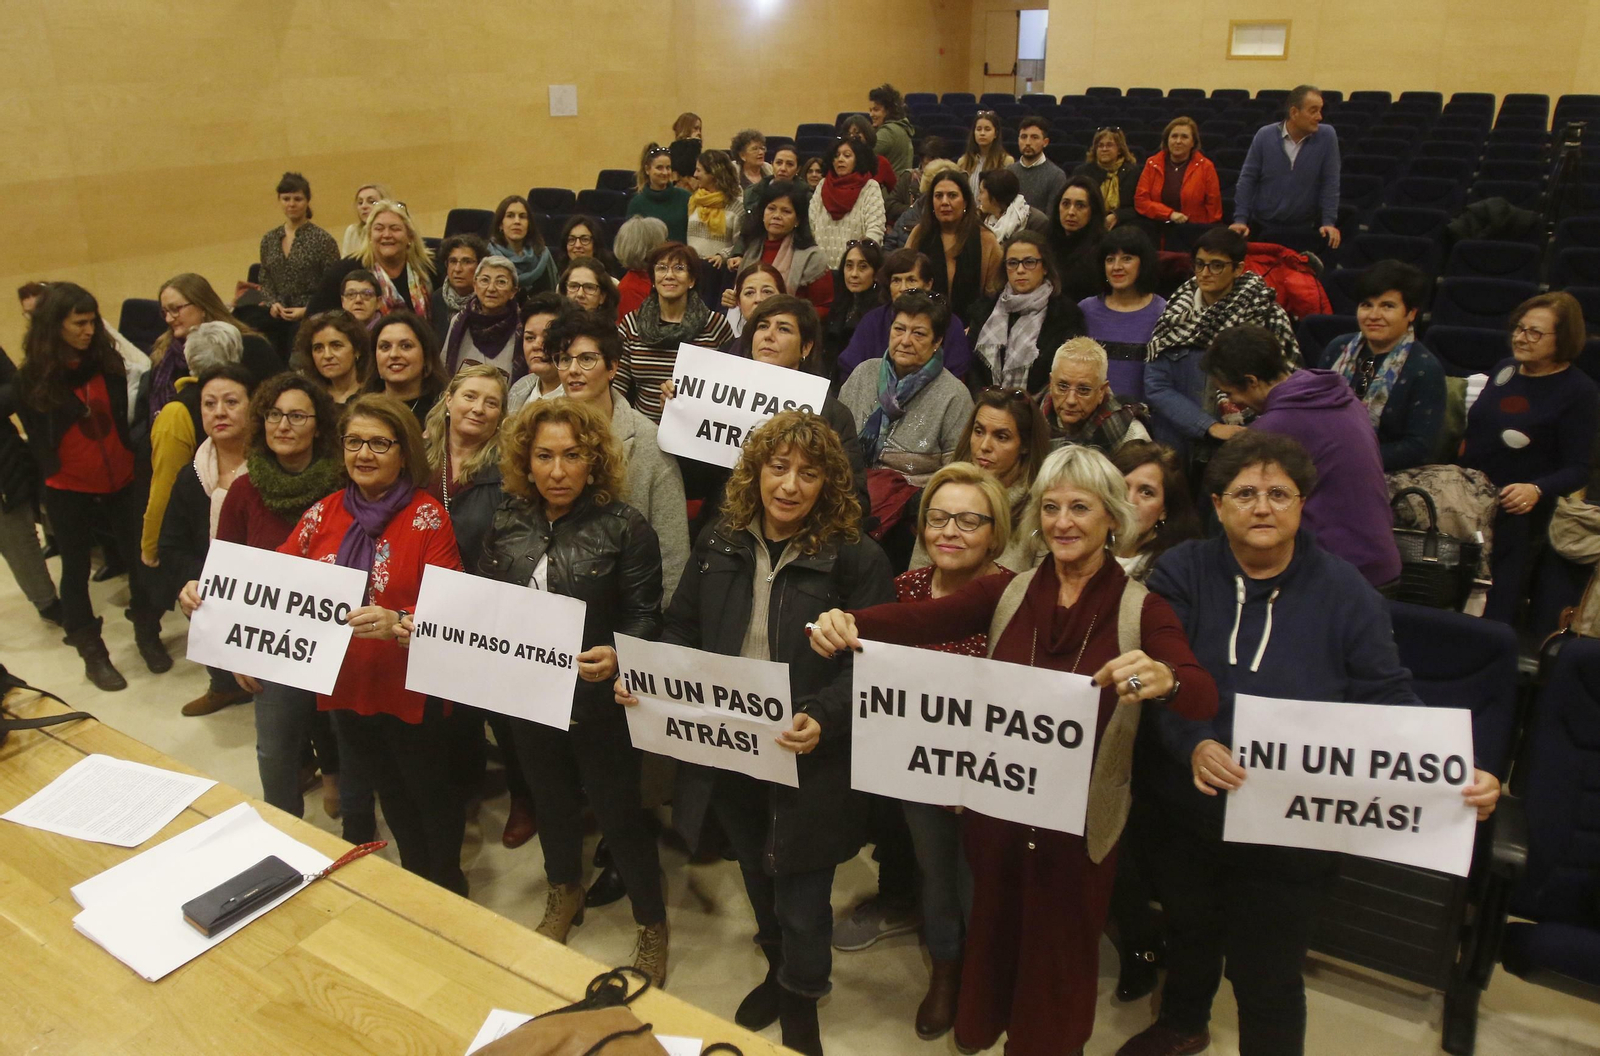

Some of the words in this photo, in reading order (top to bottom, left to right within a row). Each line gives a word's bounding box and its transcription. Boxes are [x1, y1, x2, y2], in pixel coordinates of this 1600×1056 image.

[673, 375, 705, 399] ¡NI
[711, 382, 747, 409] UN
[200, 574, 237, 601] ¡NI
[243, 581, 281, 610] UN
[285, 590, 352, 626] PASO
[225, 623, 318, 664] ATRÁS!
[416, 620, 437, 638] ¡NI
[442, 625, 465, 645] UN
[469, 631, 511, 655] PASO
[514, 642, 573, 670] ATRÁS!
[624, 668, 657, 696] ¡NI
[664, 677, 705, 704] UN
[712, 684, 784, 722] PASO
[859, 685, 907, 719] ¡NI
[921, 692, 973, 727] UN
[985, 703, 1084, 750] PASO
[665, 716, 760, 756] ATRÁS!
[907, 744, 1038, 796] ATRÁS!
[1239, 740, 1288, 771] ¡NI
[1302, 744, 1356, 778] UN
[1369, 749, 1468, 786] PASO
[1284, 795, 1423, 834] ATRÁS!
